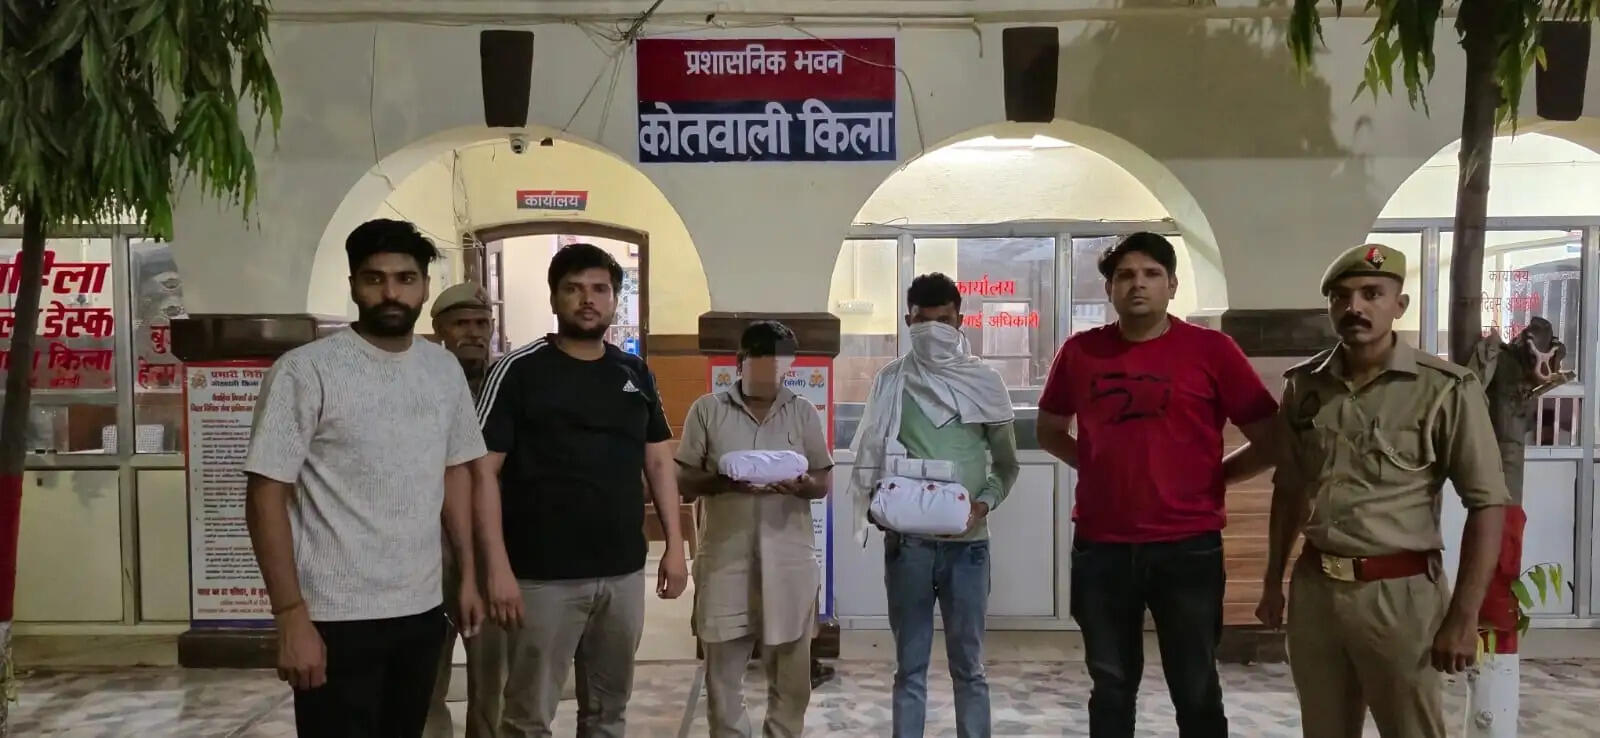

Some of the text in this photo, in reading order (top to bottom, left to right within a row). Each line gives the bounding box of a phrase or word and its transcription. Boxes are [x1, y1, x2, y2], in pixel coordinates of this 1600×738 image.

[684, 44, 845, 76] प्रशासनिक भवन
[640, 98, 893, 156] कोतवाली किला
[524, 191, 580, 208] कार्यालय
[43, 301, 114, 338] डेस्क
[988, 309, 1041, 329] अधिकारी
[48, 342, 114, 371] किला
